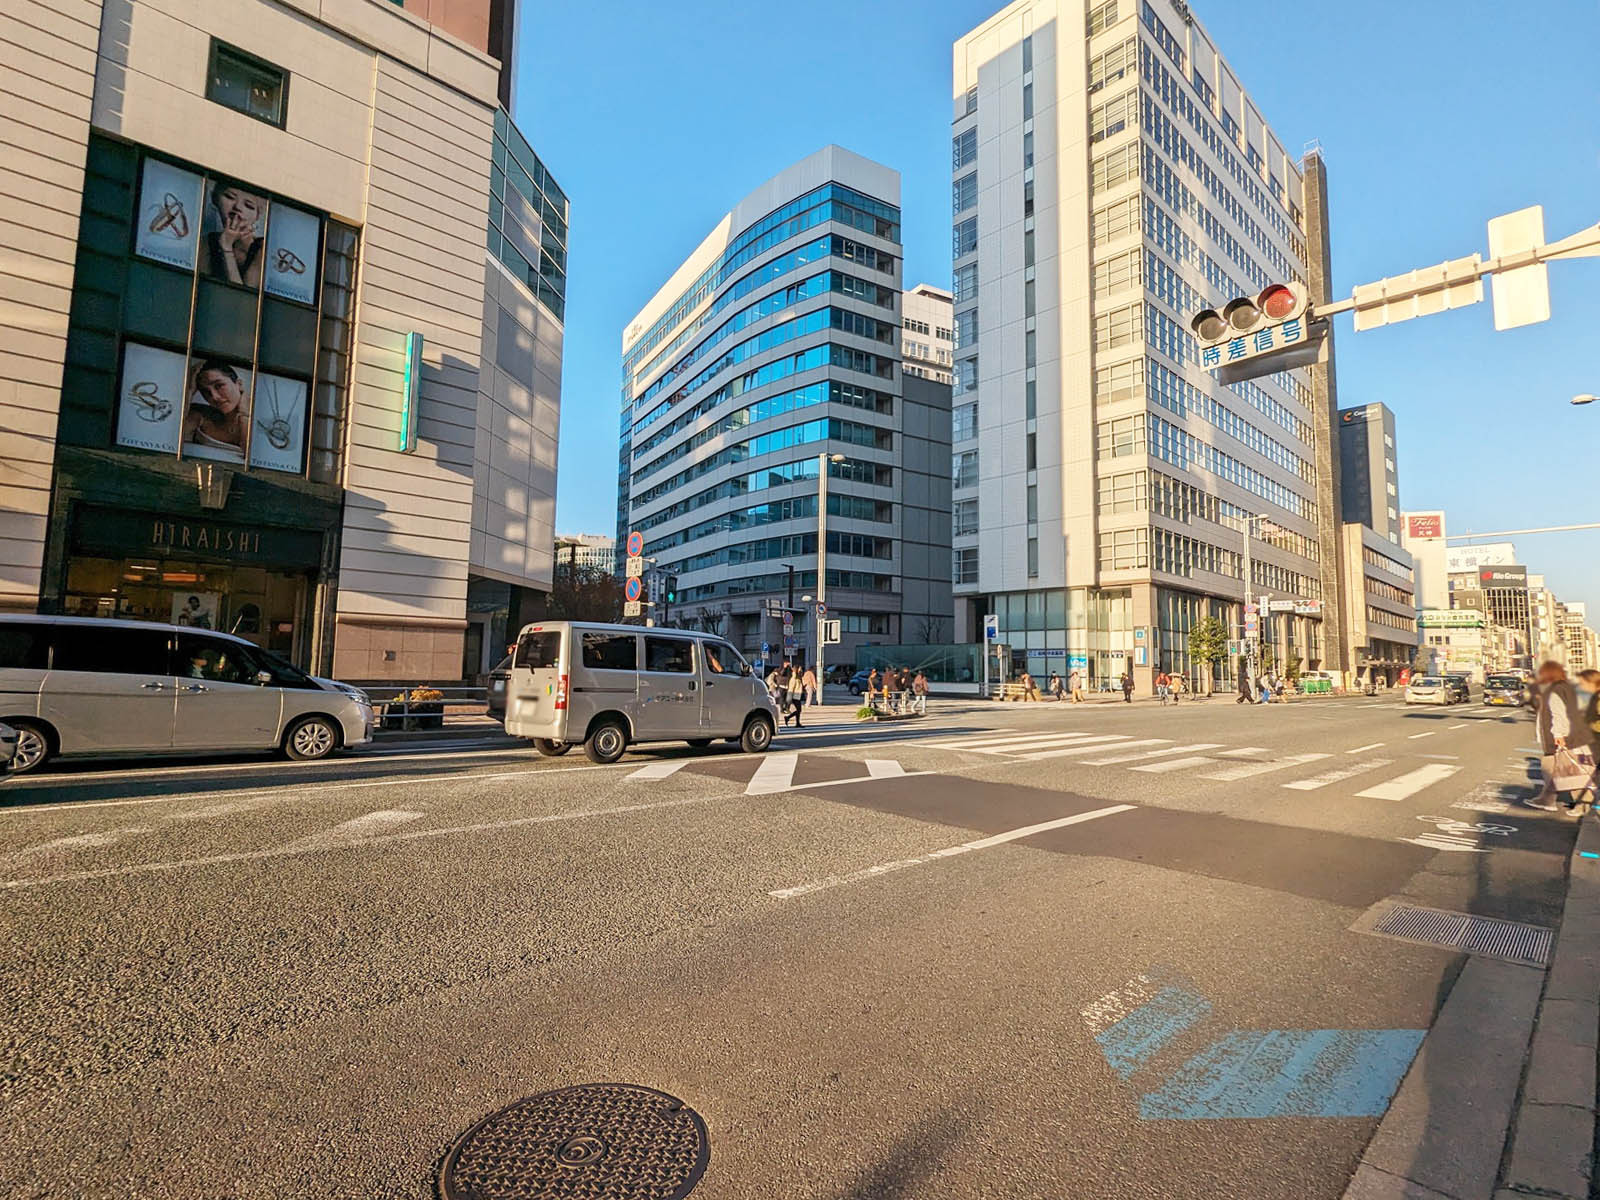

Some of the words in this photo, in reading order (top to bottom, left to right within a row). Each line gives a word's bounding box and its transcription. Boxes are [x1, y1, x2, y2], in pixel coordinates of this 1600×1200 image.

[1202, 319, 1302, 367] 時差信号
[153, 521, 260, 553] HIRAISHI
[1449, 556, 1504, 568] 東横イン
